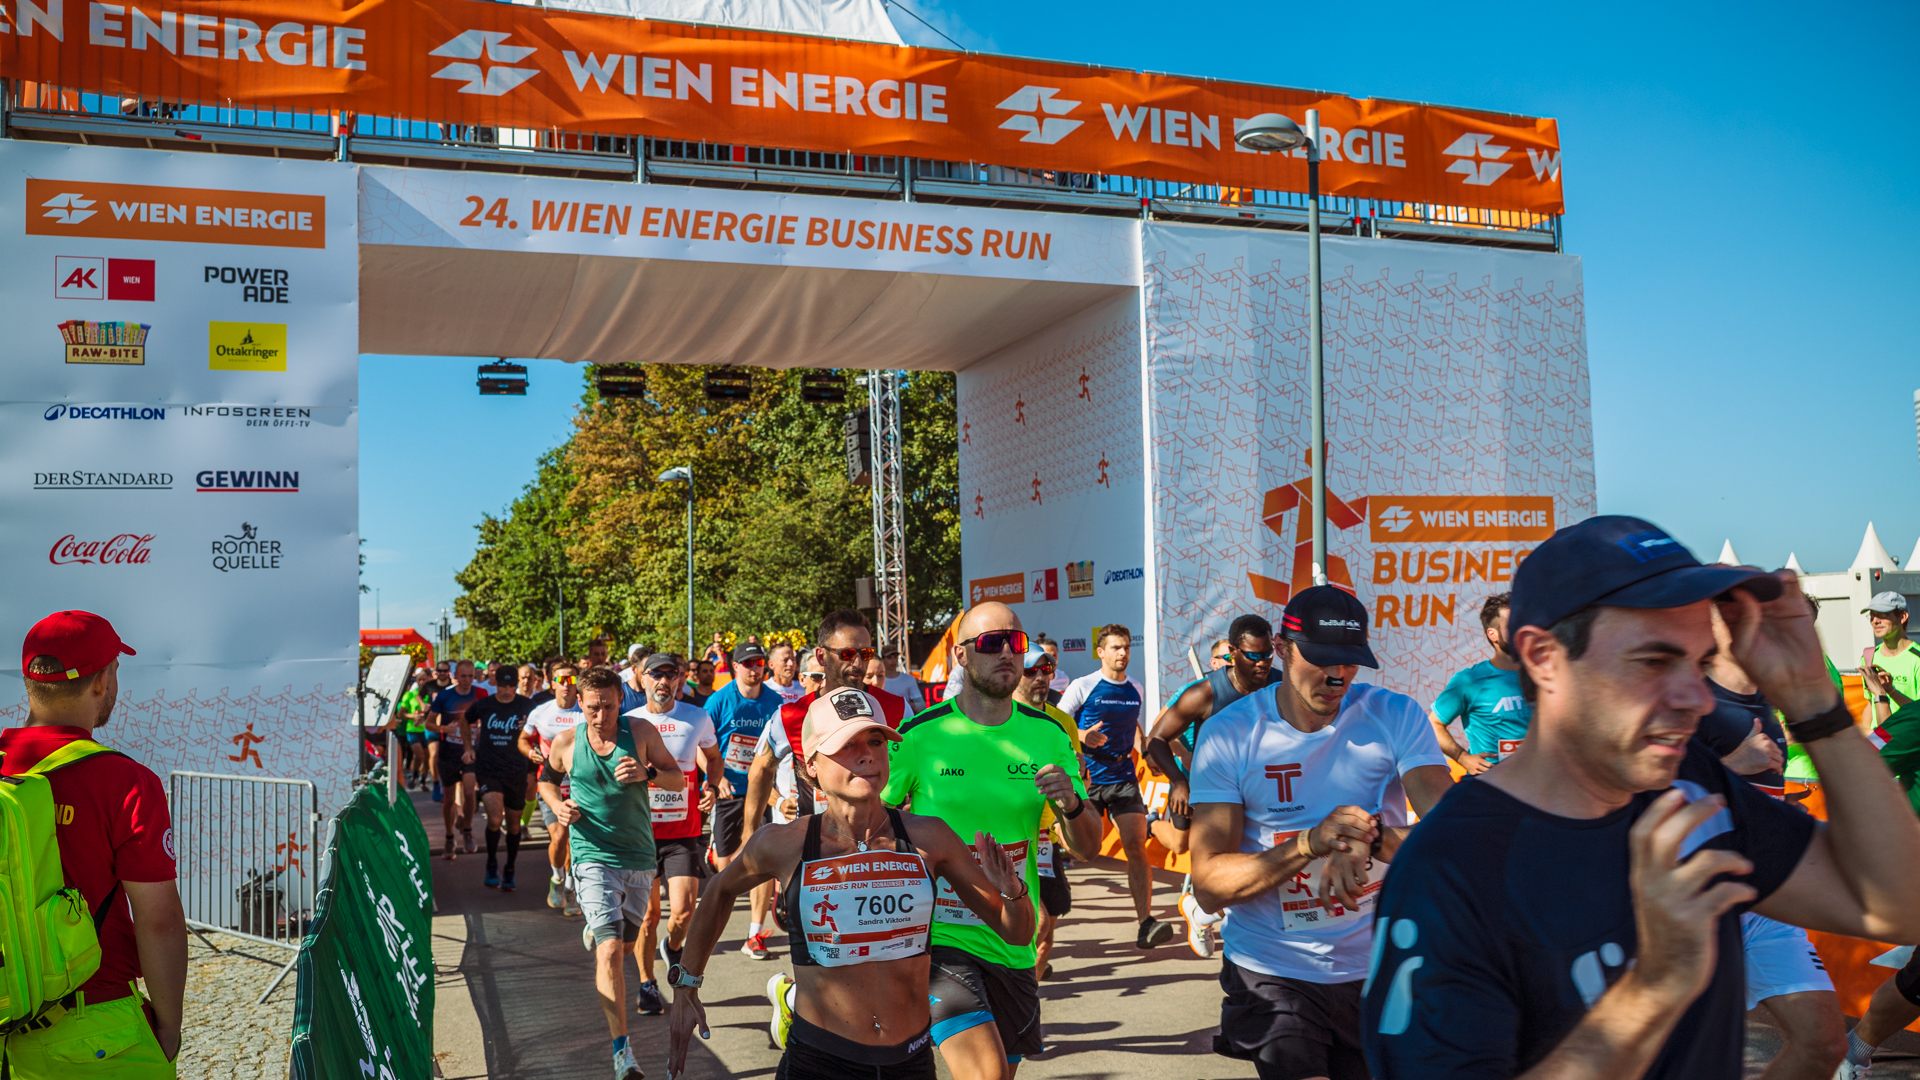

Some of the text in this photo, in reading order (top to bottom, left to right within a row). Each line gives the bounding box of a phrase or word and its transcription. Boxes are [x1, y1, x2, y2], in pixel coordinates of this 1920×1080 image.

[89, 1, 367, 71] ENERGIE
[562, 49, 949, 123] WIEN ENERGIE
[1101, 103, 1220, 151] WIEN
[109, 201, 313, 231] WIEN ENERGIE
[460, 195, 1051, 262] 24. WIEN ENERGIE BUSINESS RUN
[61, 267, 140, 289] AK WIEN
[204, 266, 289, 286] POWER
[243, 286, 289, 304] ADE
[216, 344, 279, 359] Ottakringer
[69, 407, 165, 420] DECATHLON
[184, 406, 310, 418] INFOSCREEN
[246, 418, 311, 427] DEIN ÖFFI-TV
[196, 470, 299, 488] GEWINN
[1419, 510, 1547, 528] WIEN ENERGIE
[49, 533, 157, 565] Coca-Cola
[212, 555, 281, 572] QUELLE
[1112, 567, 1144, 582] DECATHLON
[1375, 594, 1456, 628] RUN
[730, 717, 764, 728] schnell
[940, 767, 965, 777] JAKO
[654, 793, 683, 803] 5006A
[837, 861, 919, 875] WIEN ENERGIE
[809, 882, 849, 892] BUSINESS
[851, 882, 868, 890] RUN
[854, 893, 914, 916] 760C
[858, 915, 911, 926] Sandra Viktoria
[820, 945, 840, 954] POWER
